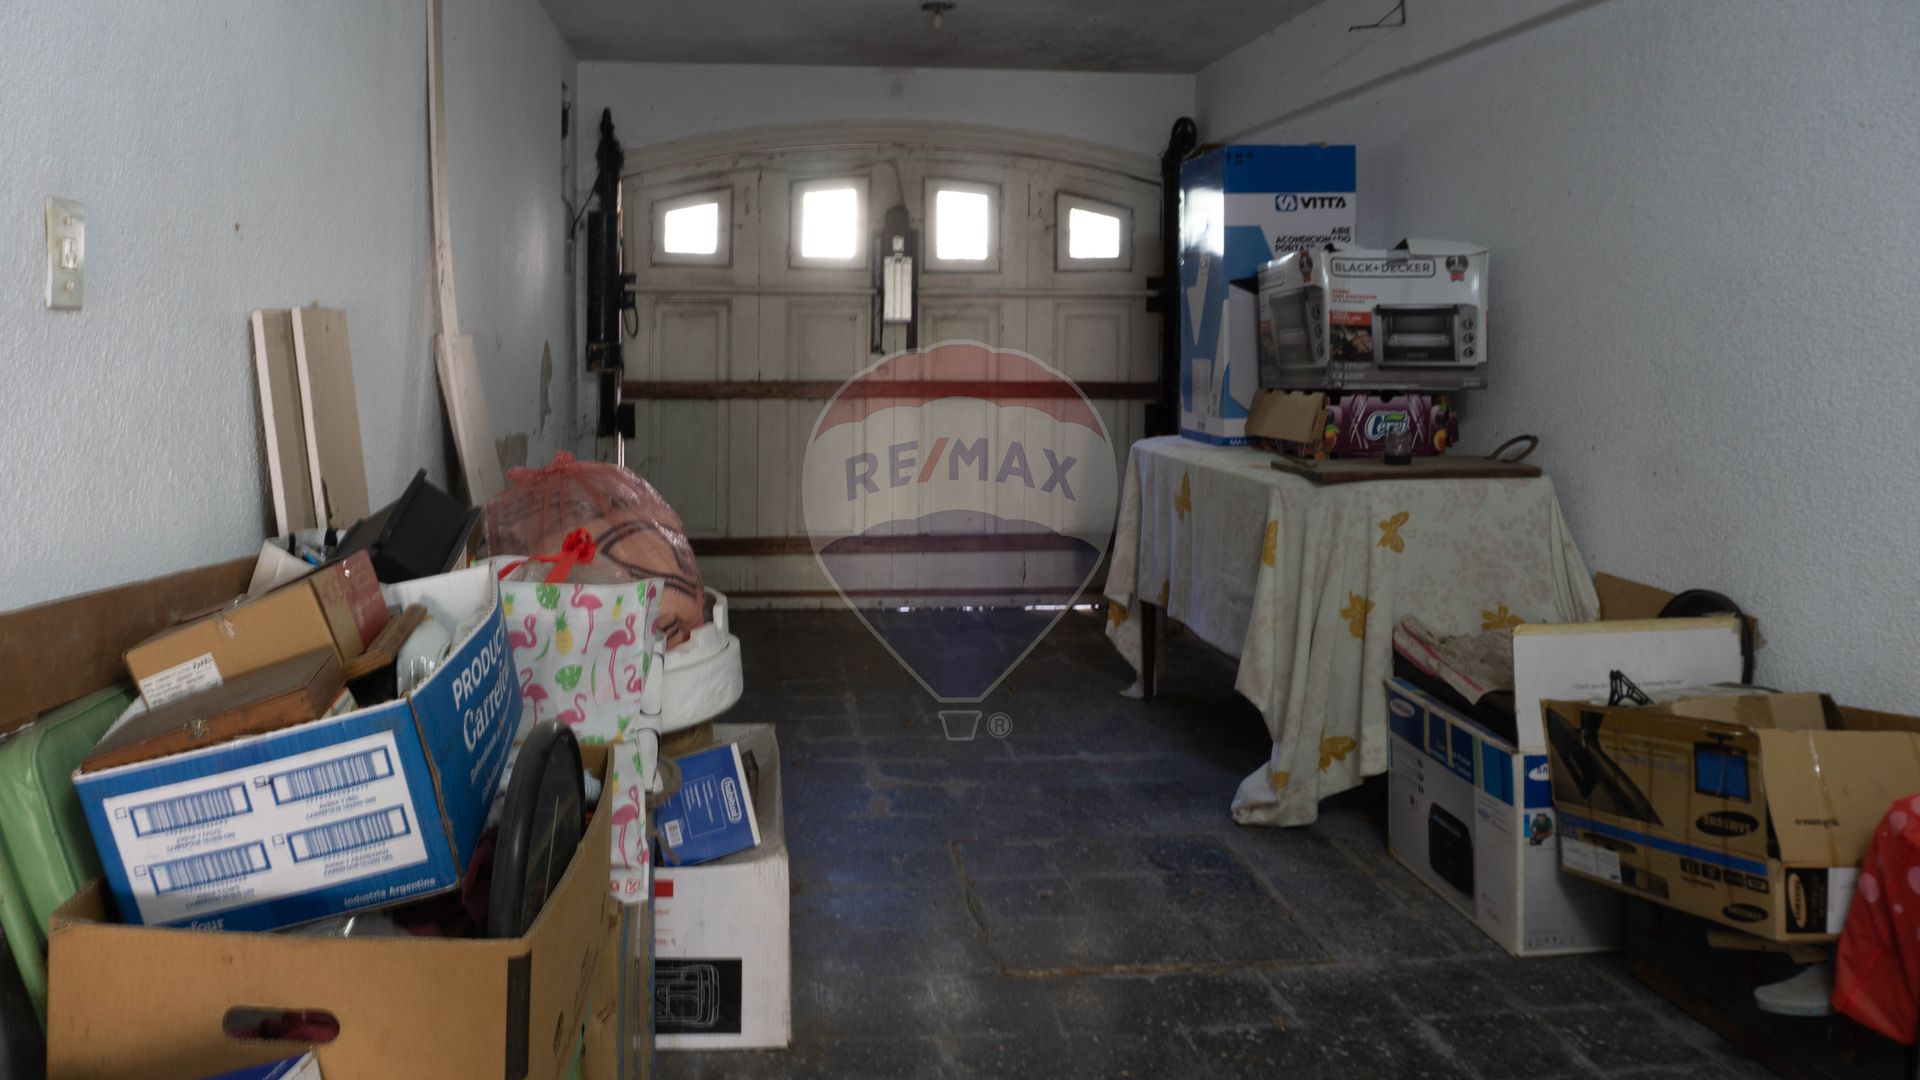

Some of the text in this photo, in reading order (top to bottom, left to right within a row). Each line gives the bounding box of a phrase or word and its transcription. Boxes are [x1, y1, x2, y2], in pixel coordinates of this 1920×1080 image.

[1300, 195, 1347, 209] VITTA
[1334, 262, 1431, 274] BLACK+DECKER
[389, 877, 436, 897] Argentina
